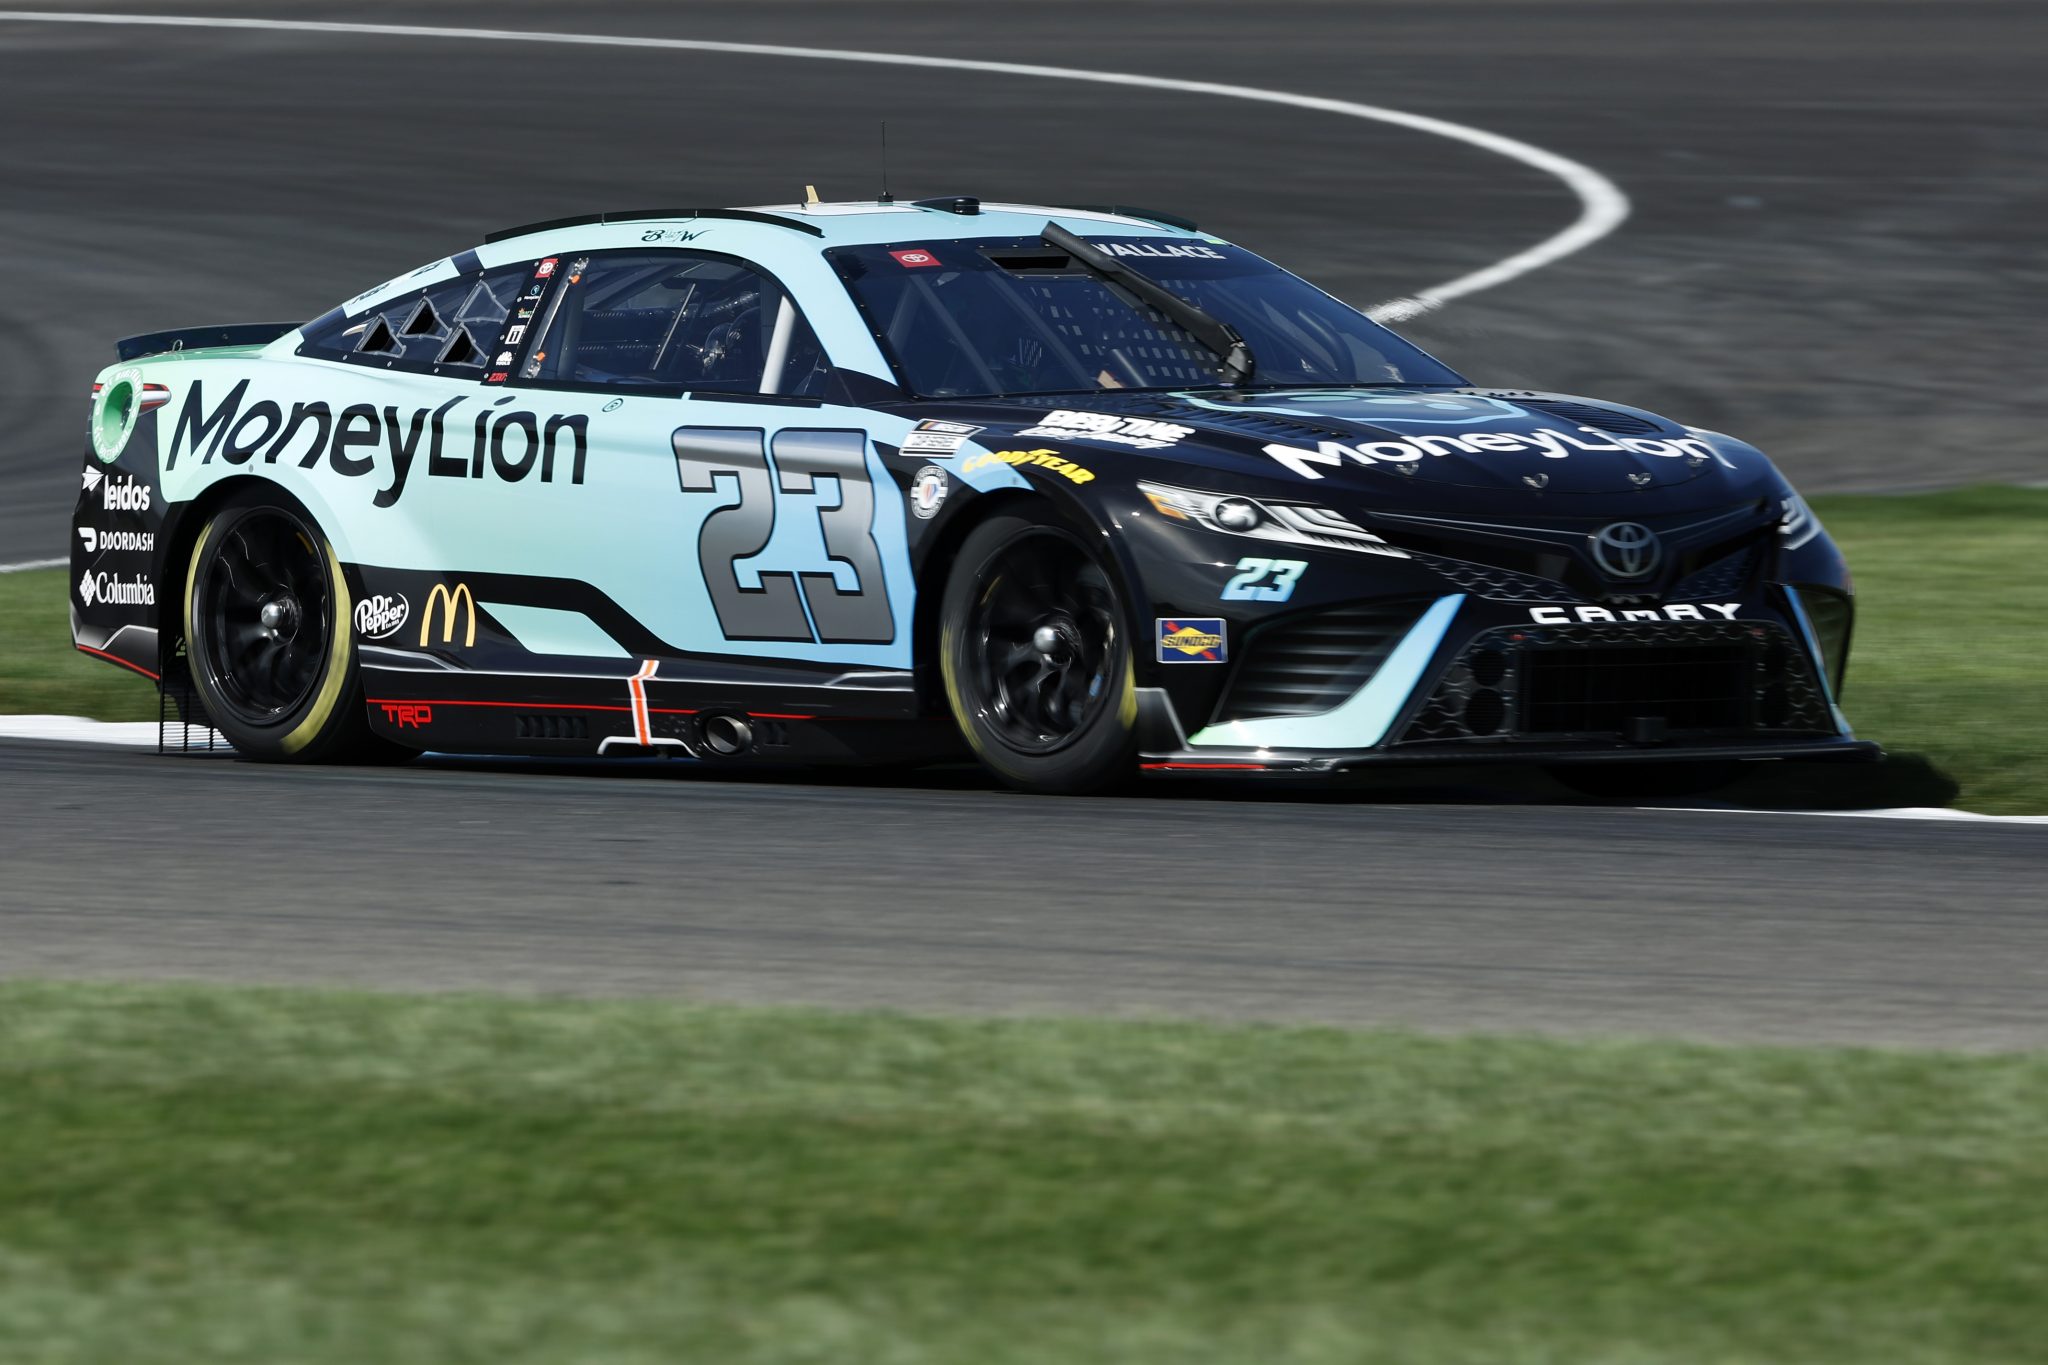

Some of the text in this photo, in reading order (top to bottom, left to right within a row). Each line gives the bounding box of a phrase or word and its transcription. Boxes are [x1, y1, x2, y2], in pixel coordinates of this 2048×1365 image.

[166, 379, 588, 508] MoneyLion
[1261, 426, 1738, 480] MoneyLion
[104, 474, 151, 511] leidos
[100, 531, 154, 551] DOORDASH
[671, 425, 897, 646] 23
[96, 571, 155, 605] Columbia
[1220, 557, 1309, 602] 23
[355, 599, 405, 635] Pepper
[372, 595, 393, 615] Dr
[1162, 634, 1222, 649] SUNOCO
[381, 705, 432, 729] TRD
